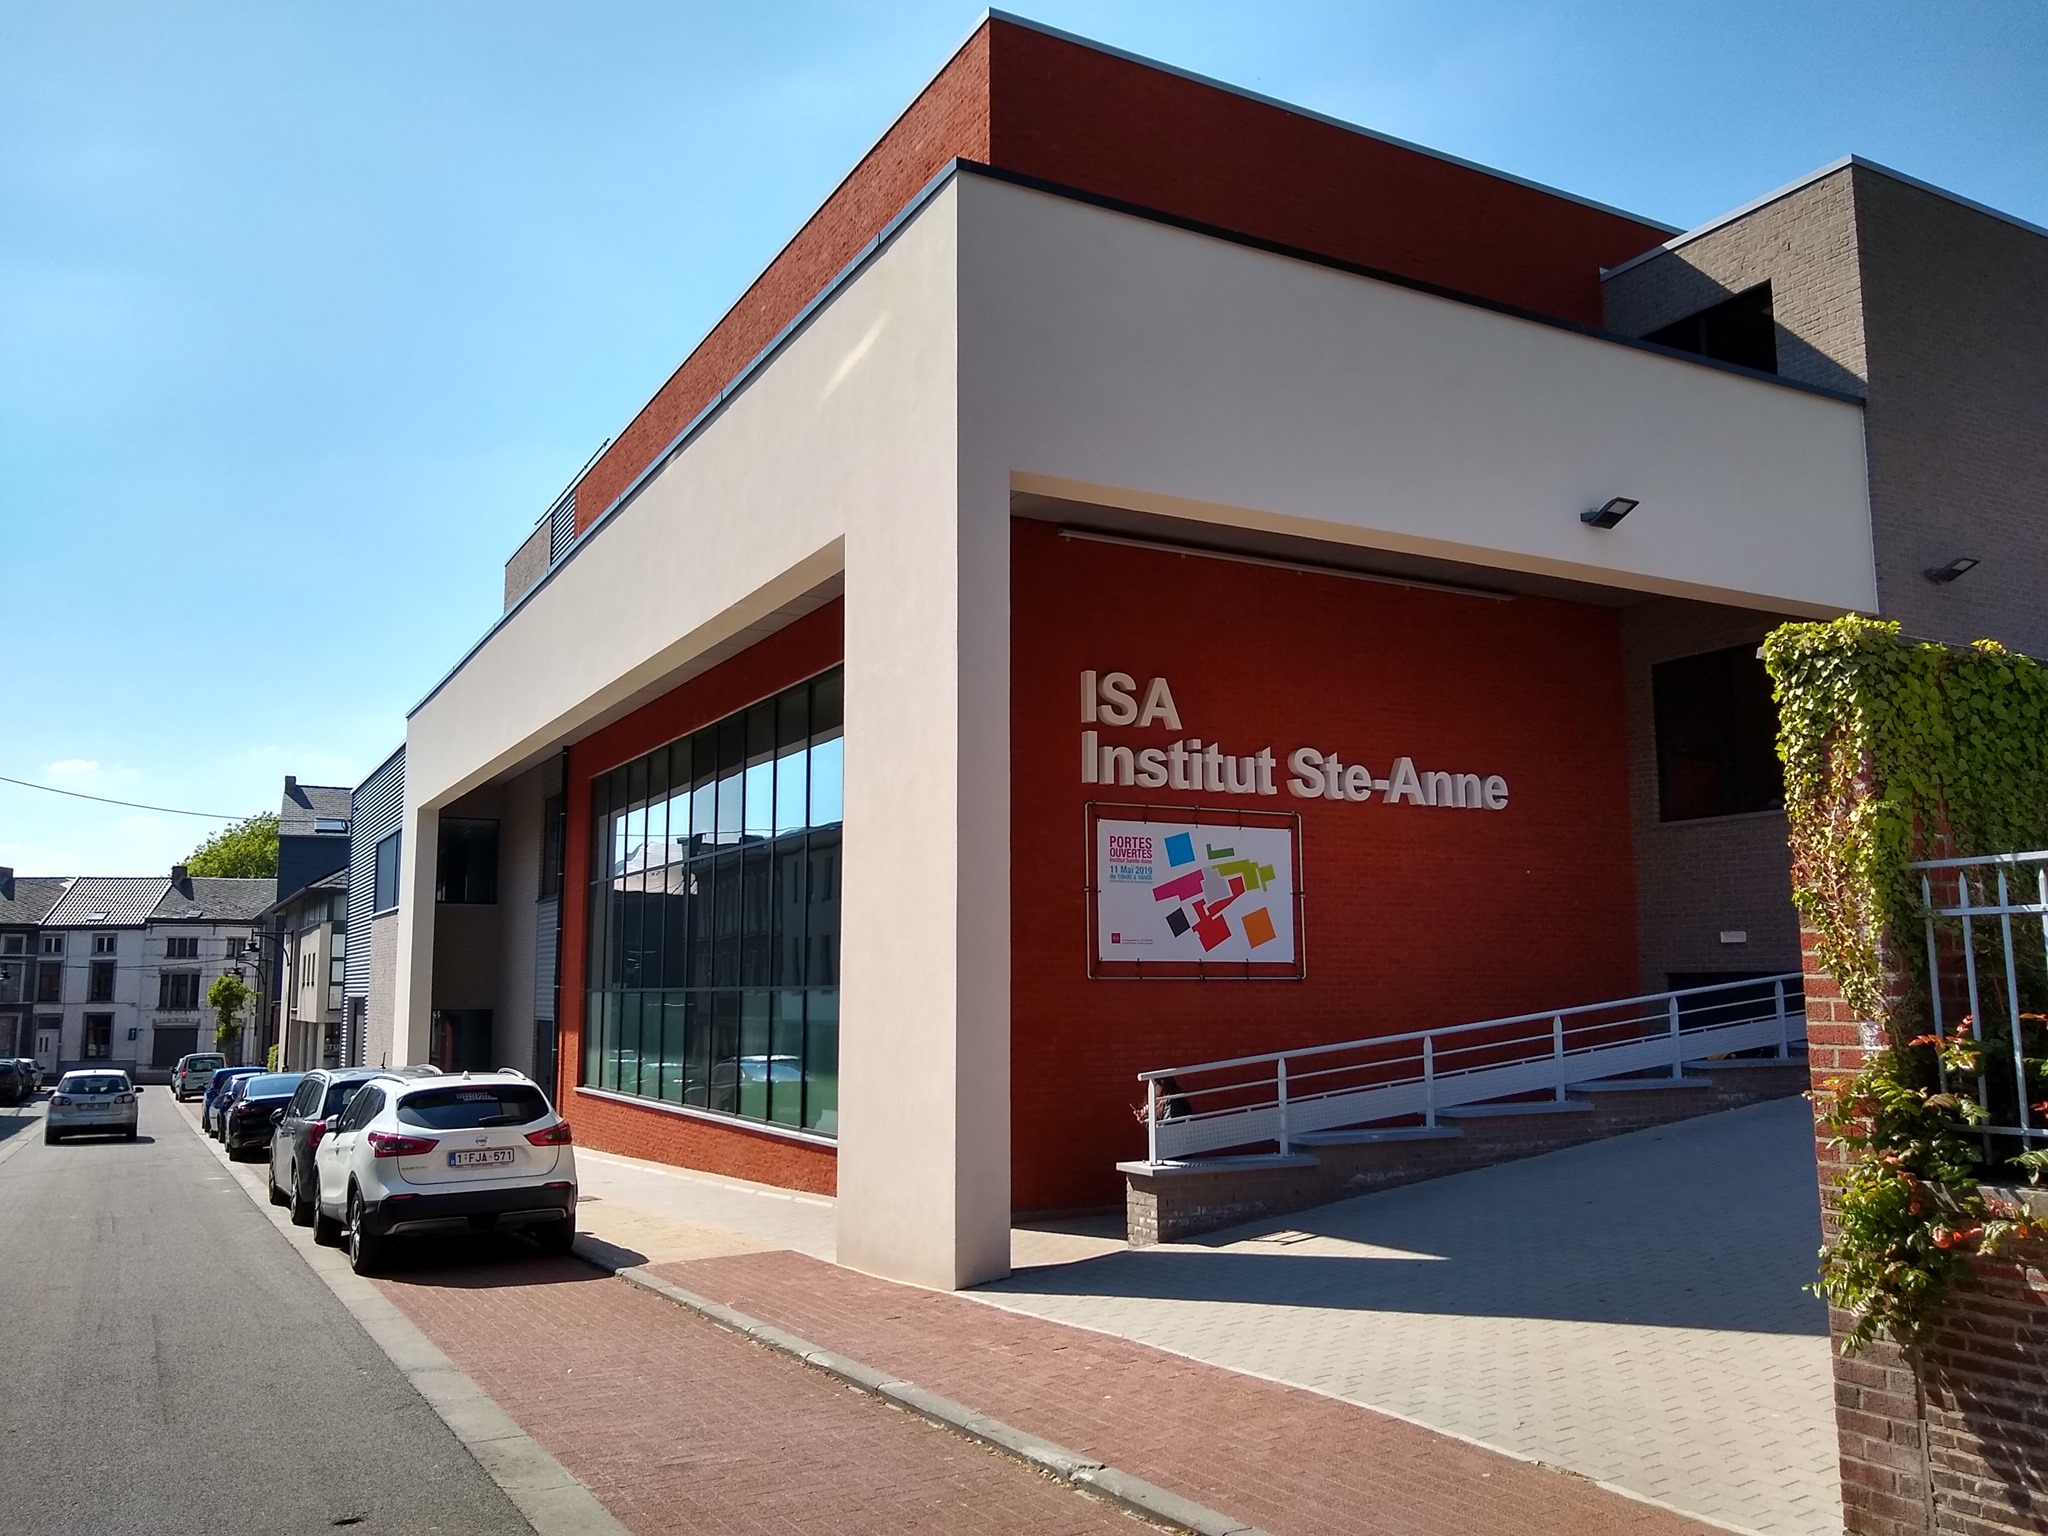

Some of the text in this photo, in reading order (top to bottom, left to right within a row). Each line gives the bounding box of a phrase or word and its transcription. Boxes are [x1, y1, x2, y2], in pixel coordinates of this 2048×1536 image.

[1081, 670, 1182, 731] ISA
[1081, 731, 1509, 810] Institut Ste-Anne
[1110, 836, 1152, 849] PORTES
[1110, 847, 1152, 859] OUVERTES
[1120, 866, 1133, 874] Mai
[1135, 866, 1152, 874] 2019
